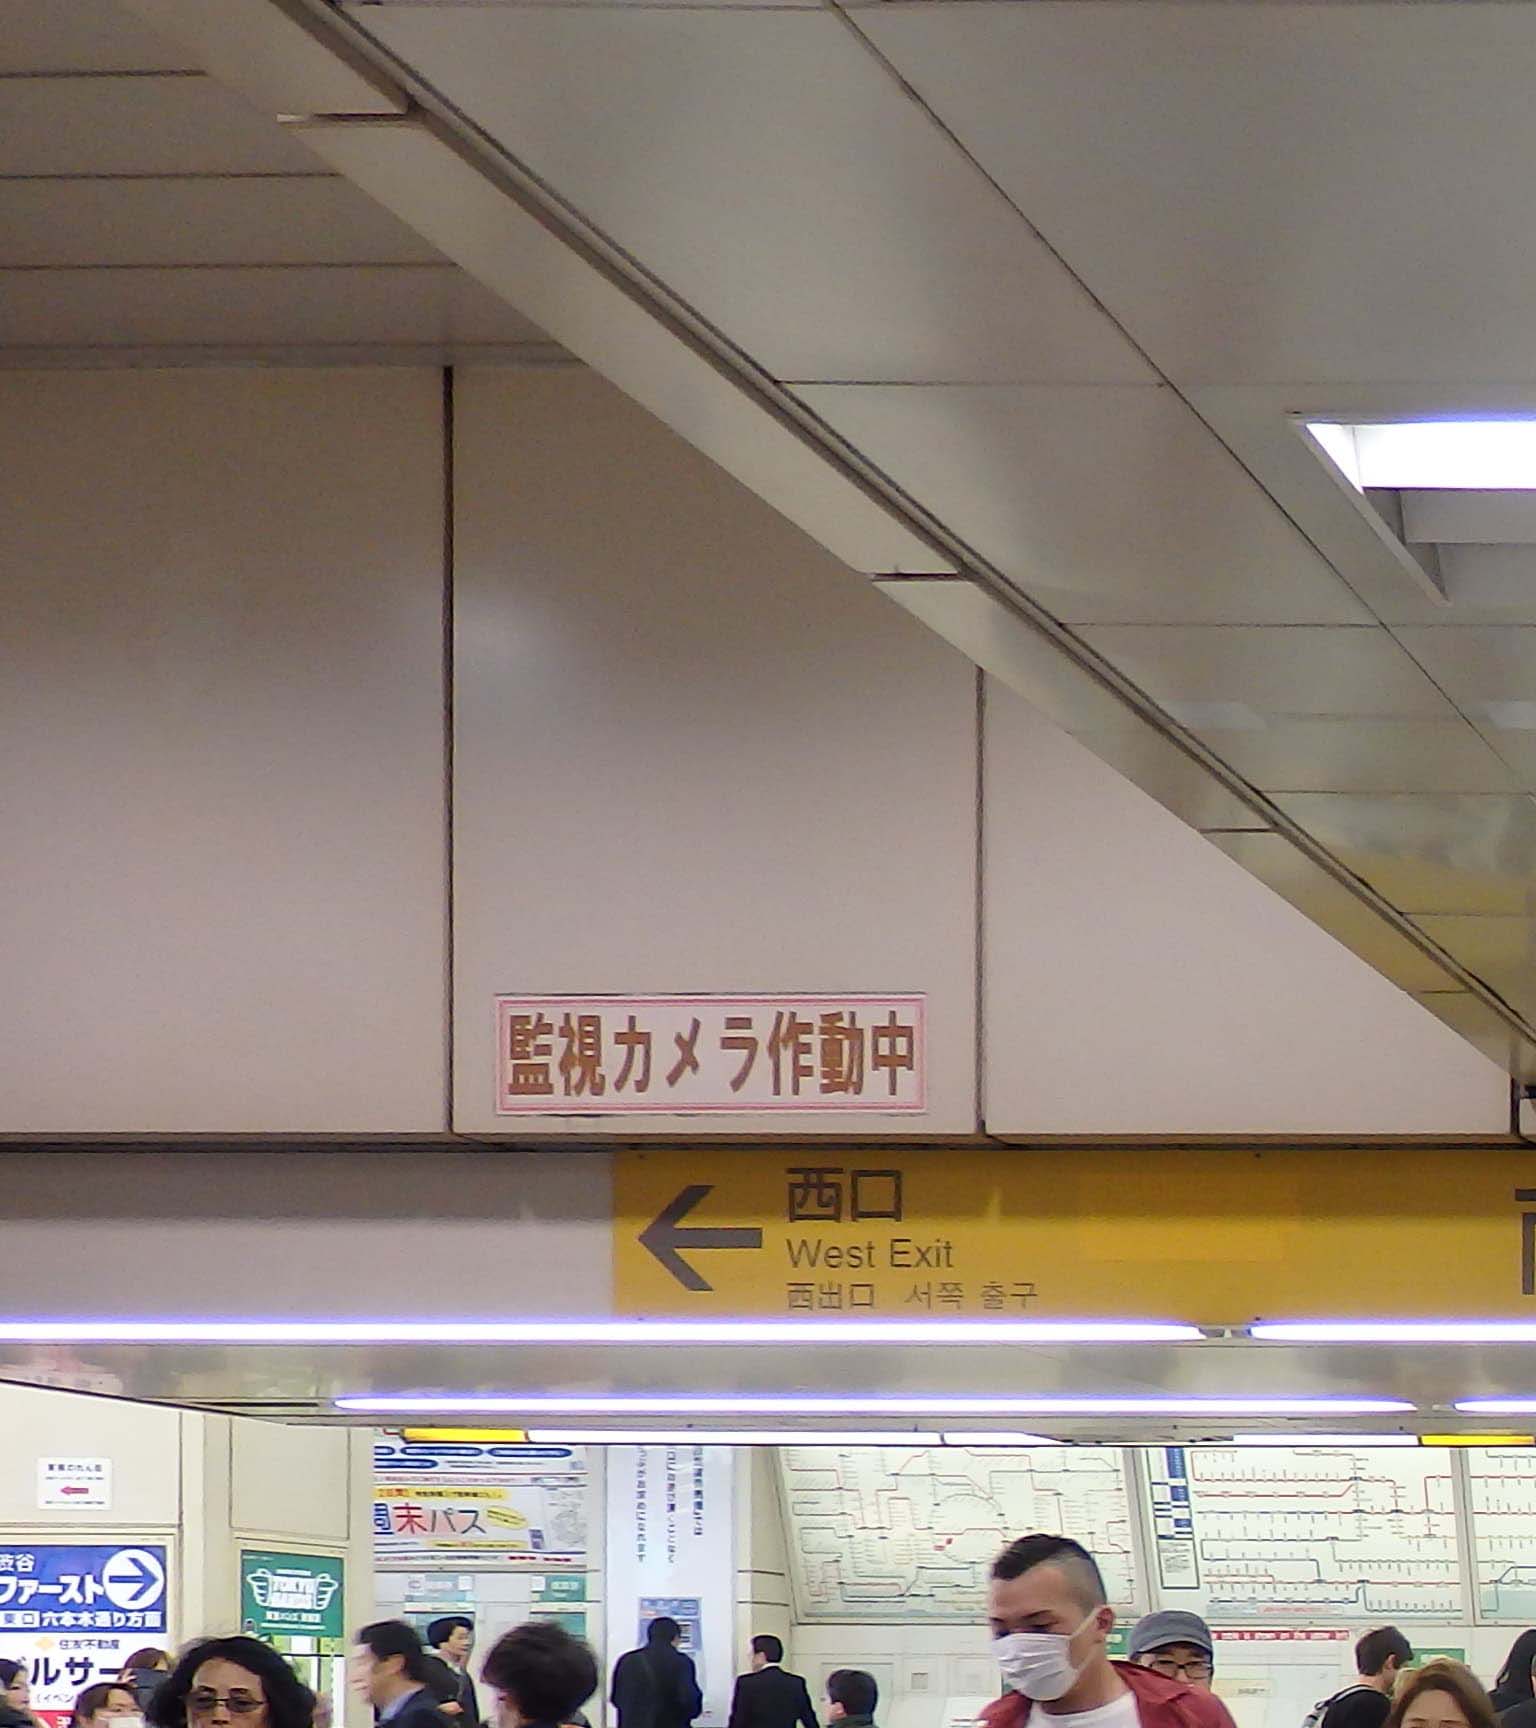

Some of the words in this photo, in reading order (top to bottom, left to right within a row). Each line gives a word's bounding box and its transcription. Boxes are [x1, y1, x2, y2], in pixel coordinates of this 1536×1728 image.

[508, 1011, 913, 1096] 監視カメラ作動中
[785, 1166, 905, 1224] 西口
[786, 1238, 875, 1269] West
[889, 1238, 954, 1269] Exit
[786, 1282, 876, 1311] 西出口
[903, 1280, 966, 1311] 서쪽
[980, 1280, 1040, 1311] 출구
[41, 1610, 162, 1629] 六本木通り方面
